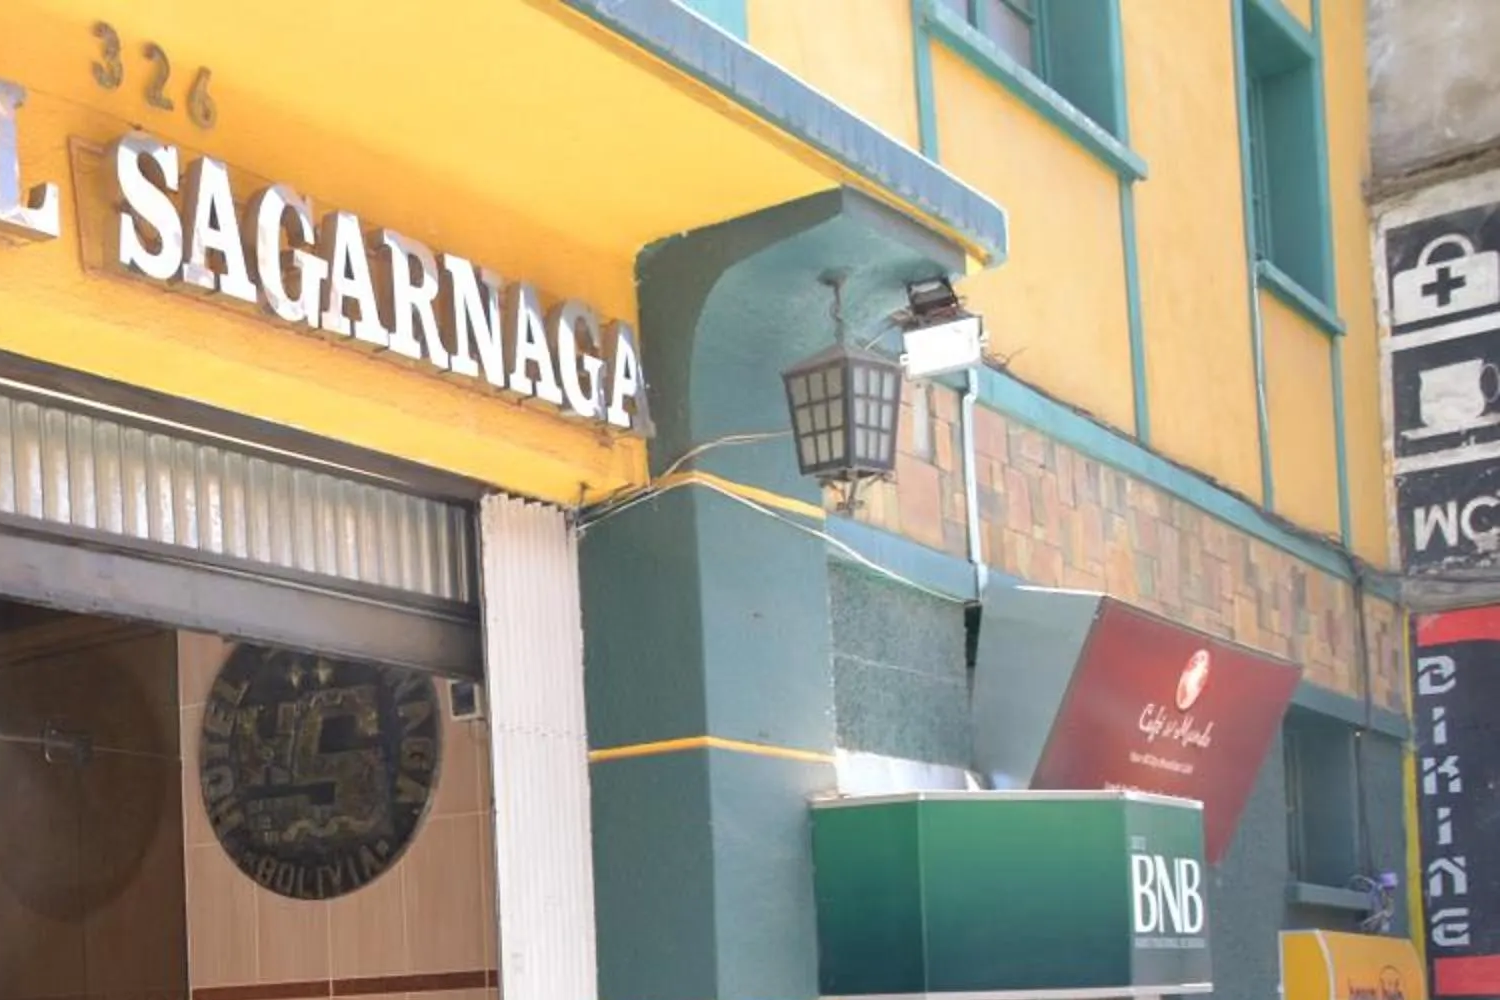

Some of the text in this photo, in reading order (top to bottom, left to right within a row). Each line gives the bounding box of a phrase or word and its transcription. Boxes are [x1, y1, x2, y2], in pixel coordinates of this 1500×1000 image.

[91, 20, 219, 131] 326
[114, 130, 652, 432] SAGARNAGA
[1131, 854, 1204, 933] BNB
